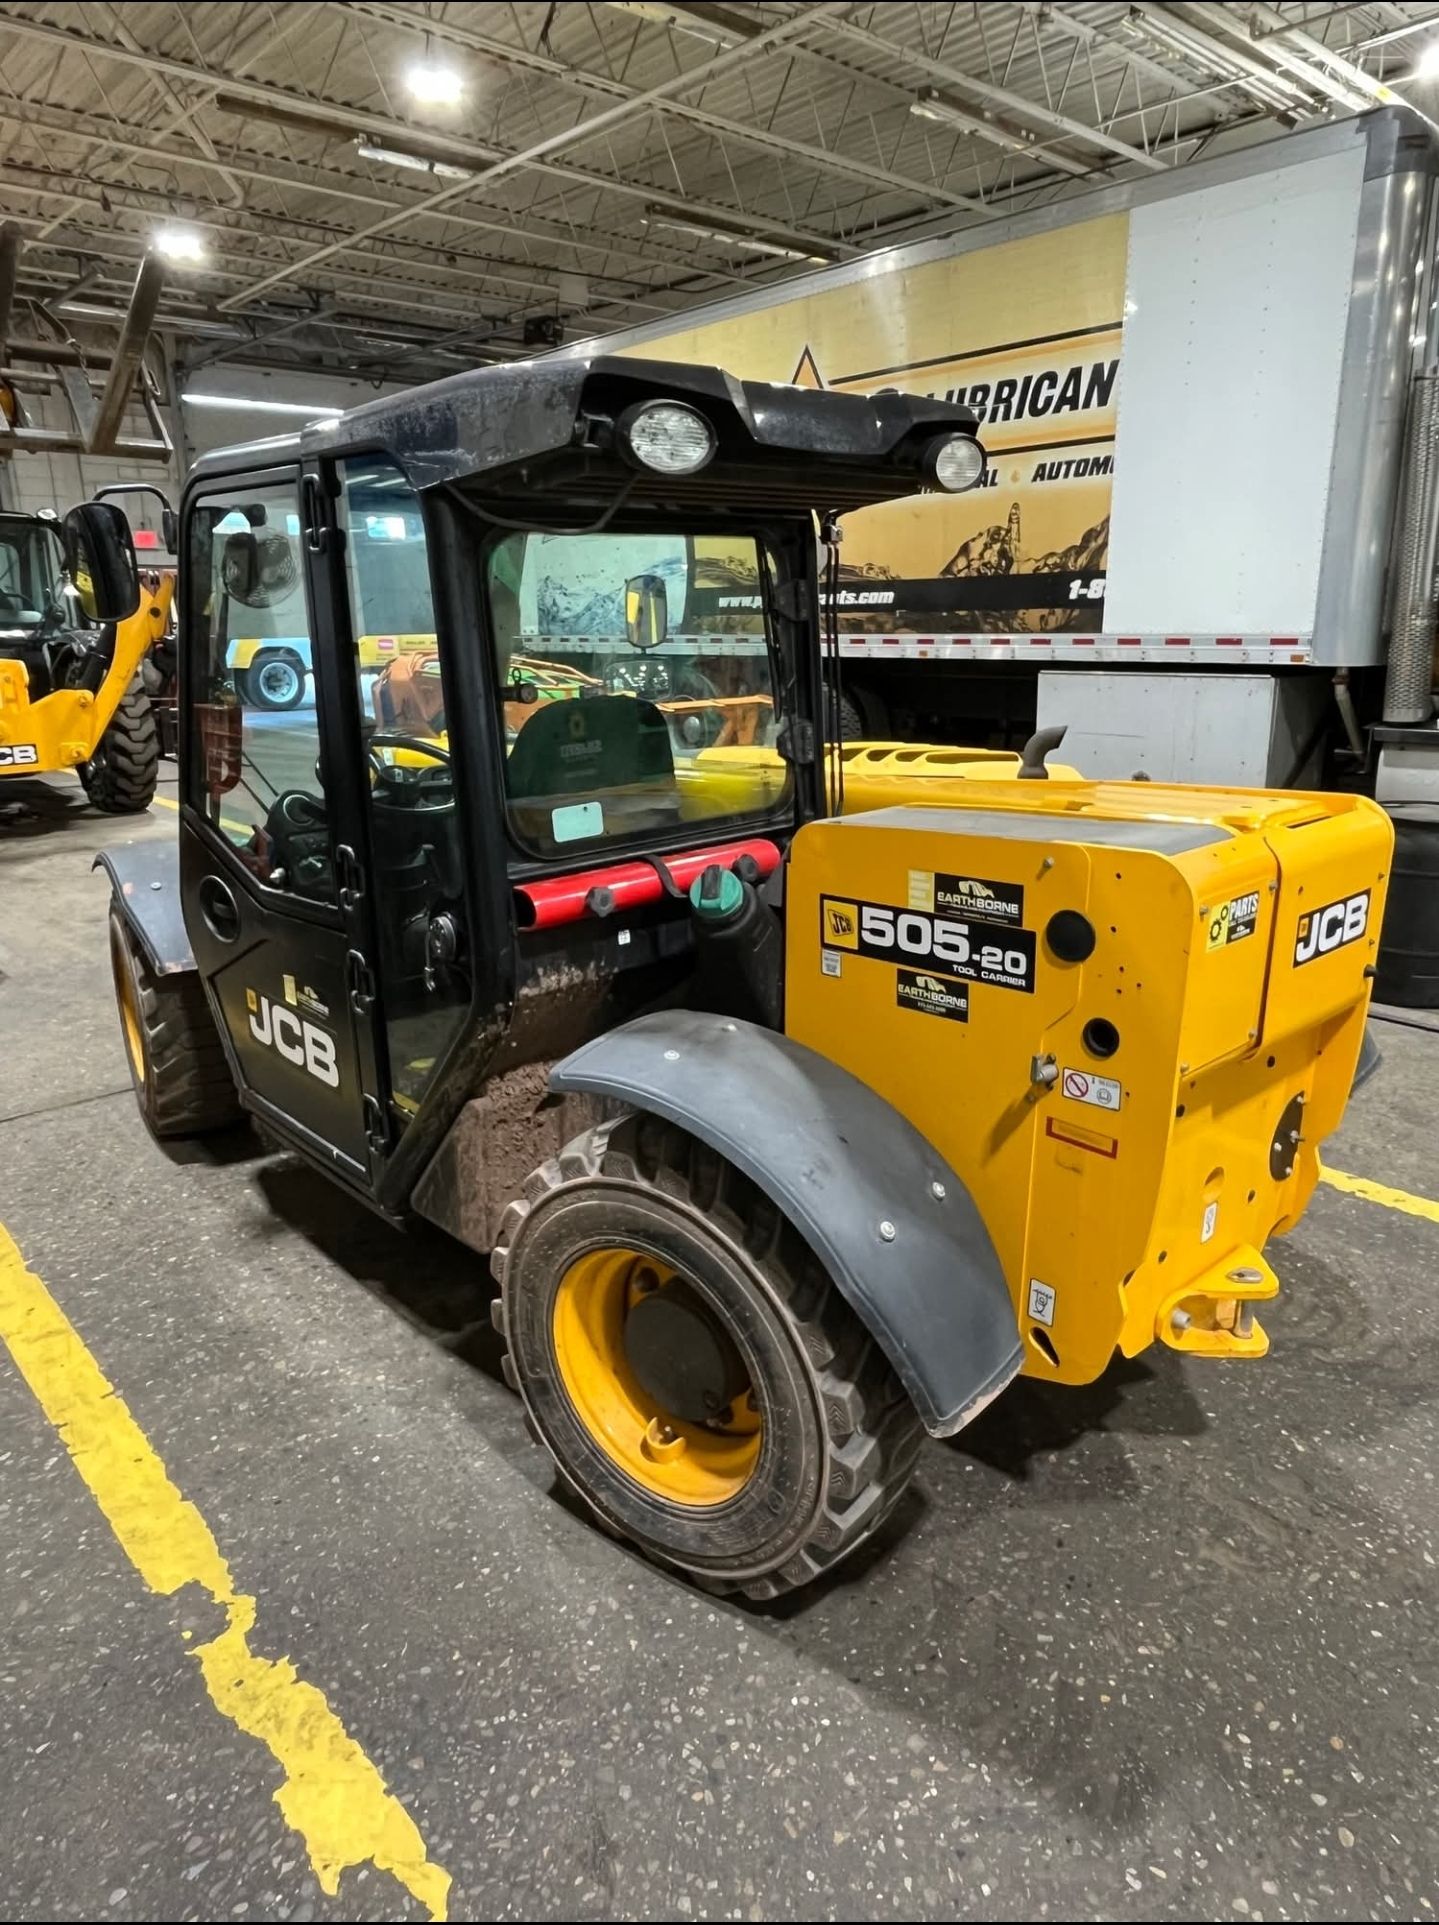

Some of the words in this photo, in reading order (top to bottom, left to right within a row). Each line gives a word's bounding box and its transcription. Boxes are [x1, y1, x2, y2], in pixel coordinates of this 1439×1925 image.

[926, 359, 1120, 424] BRICAN
[1031, 455, 1114, 483] AUTOM
[937, 891, 1019, 914] EARTHBORNE
[1229, 893, 1259, 921] PARTS
[1296, 894, 1369, 963] JCB
[952, 964, 977, 977] TOOL
[981, 970, 1026, 987] CARRIER
[898, 983, 968, 1008] EARTHBORNE
[249, 995, 339, 1088] JCB
